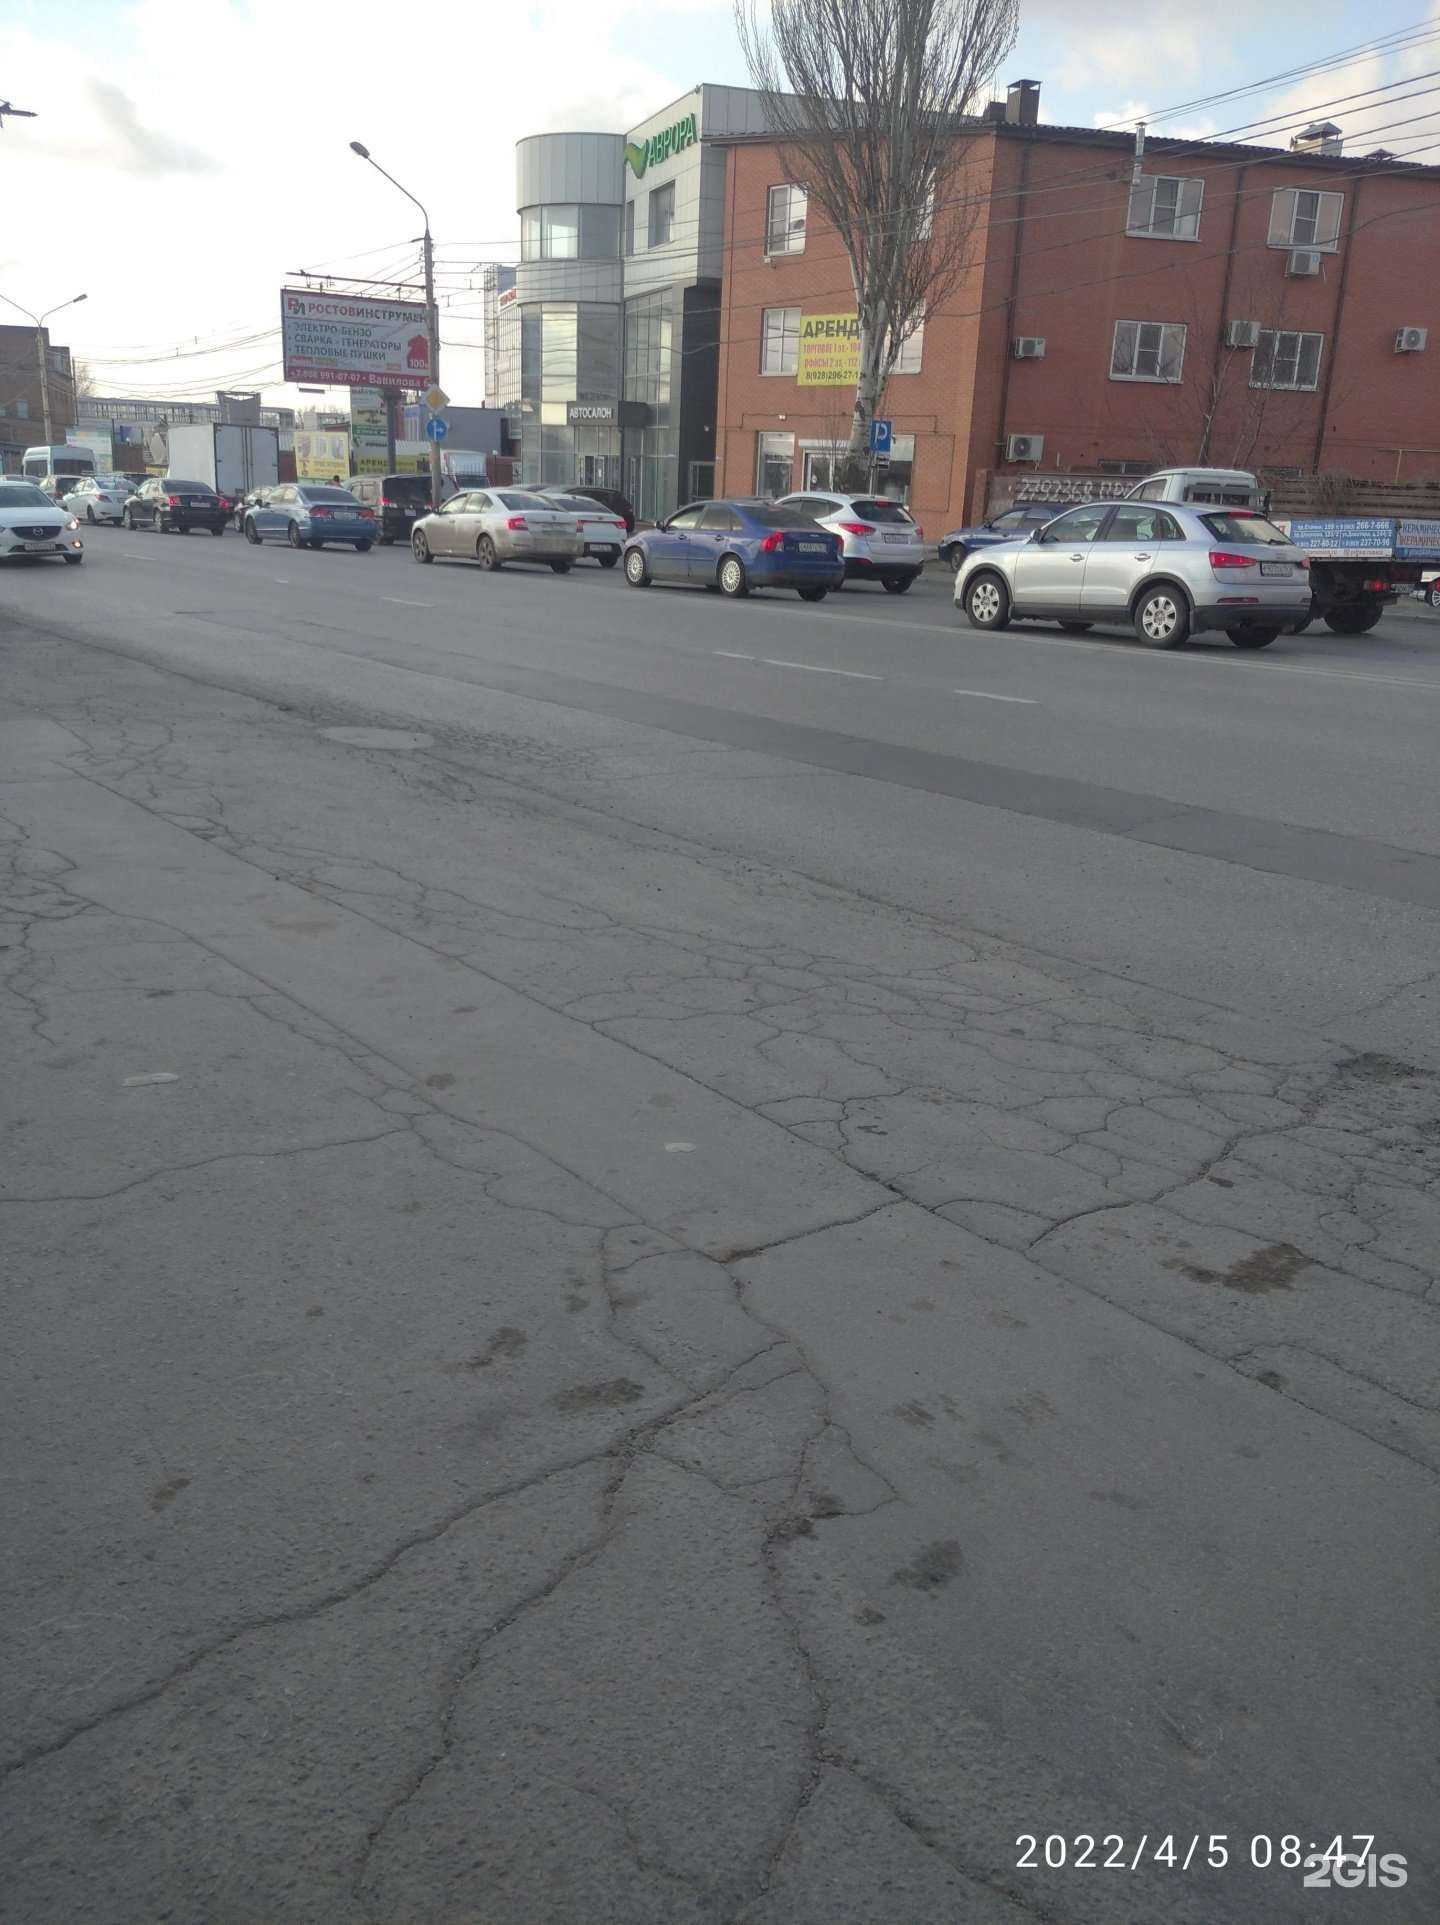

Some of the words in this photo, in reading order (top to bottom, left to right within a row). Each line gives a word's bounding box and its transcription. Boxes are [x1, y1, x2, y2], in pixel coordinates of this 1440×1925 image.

[648, 112, 698, 168] АВРОРА
[309, 303, 426, 324] РОСТОВИНСТРУМЕН
[804, 320, 860, 340] АРЕНД
[294, 335, 333, 345] СВАРКА
[341, 339, 401, 351] ГЕНЕРАТОРЫ
[295, 346, 348, 358] ТЕПЛОВЫЕ
[350, 350, 386, 361] ПУШКИ
[369, 374, 421, 388] Вавилова
[569, 407, 613, 420] АВТОСАЛОН
